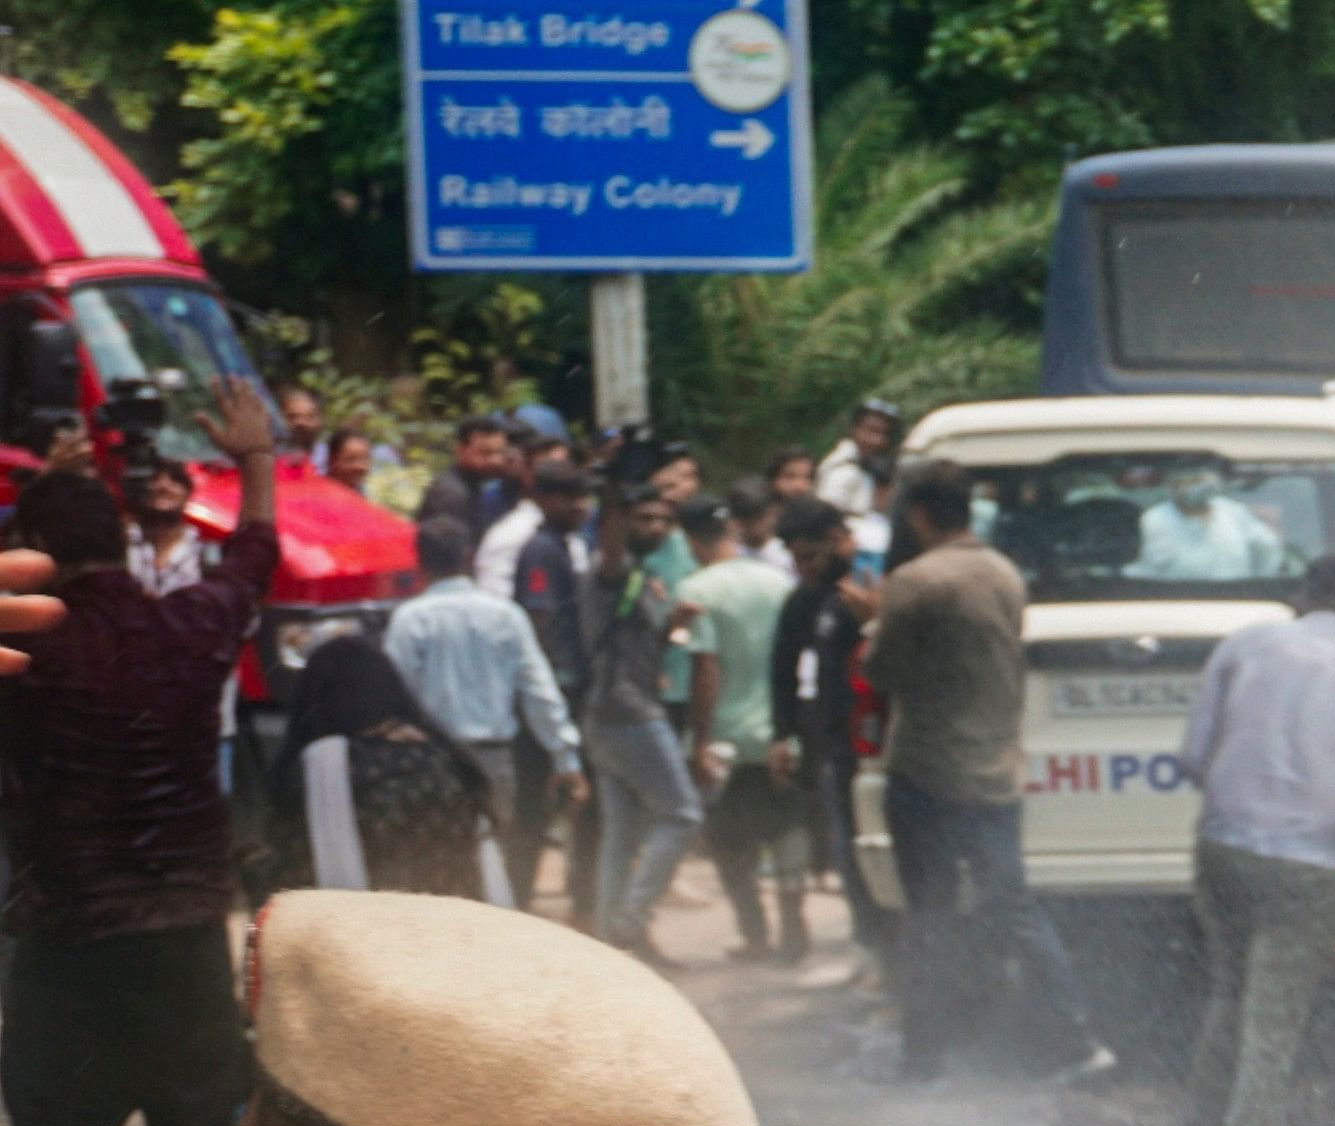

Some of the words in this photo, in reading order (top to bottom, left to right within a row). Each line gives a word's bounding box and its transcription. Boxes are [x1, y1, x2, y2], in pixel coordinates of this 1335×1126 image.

[435, 13, 526, 44] Tilak
[540, 13, 670, 55] Bridge
[440, 96, 520, 137] रेलवे
[439, 175, 591, 216] Railway
[604, 175, 741, 216] Colony
